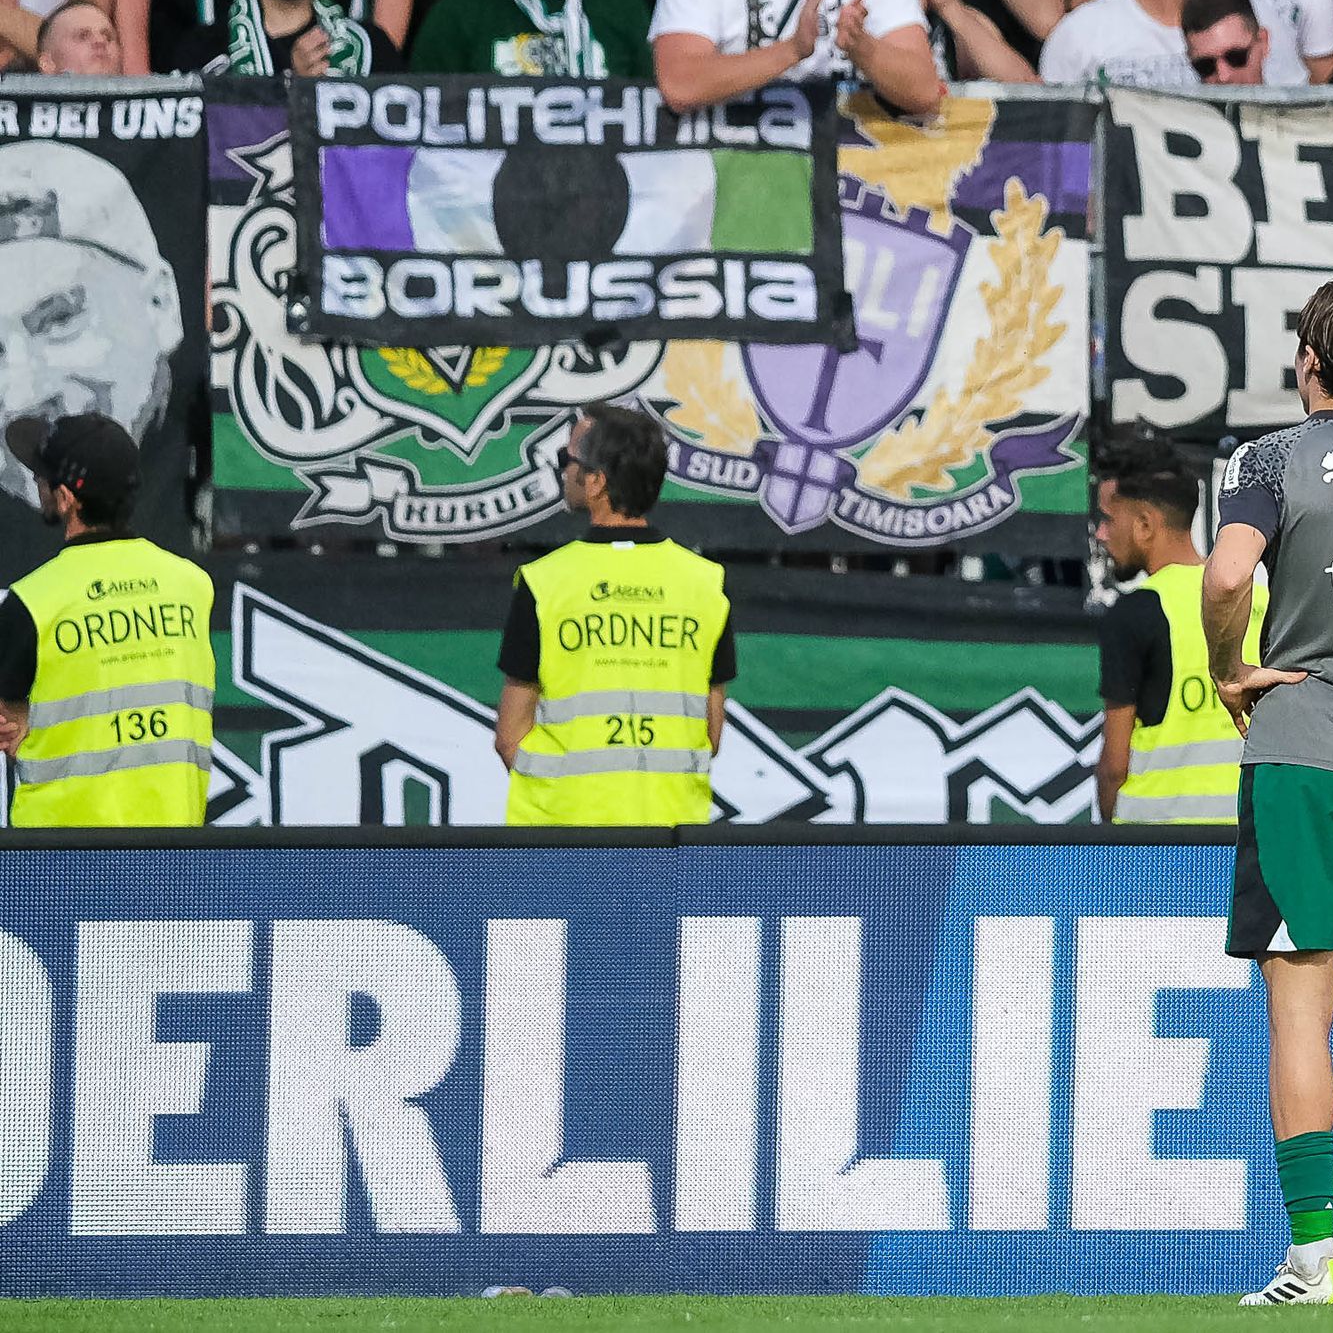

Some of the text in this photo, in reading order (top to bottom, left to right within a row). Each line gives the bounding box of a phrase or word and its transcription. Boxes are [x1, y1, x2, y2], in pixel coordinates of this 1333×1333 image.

[29, 101, 101, 139] BEI
[112, 96, 204, 140] UNS
[688, 450, 761, 488] SUD
[838, 484, 1015, 537] TIMISOARA
[55, 603, 197, 654] ORDNER
[558, 613, 699, 652] ORDNER
[110, 709, 168, 742] 136
[606, 716, 655, 746] 215
